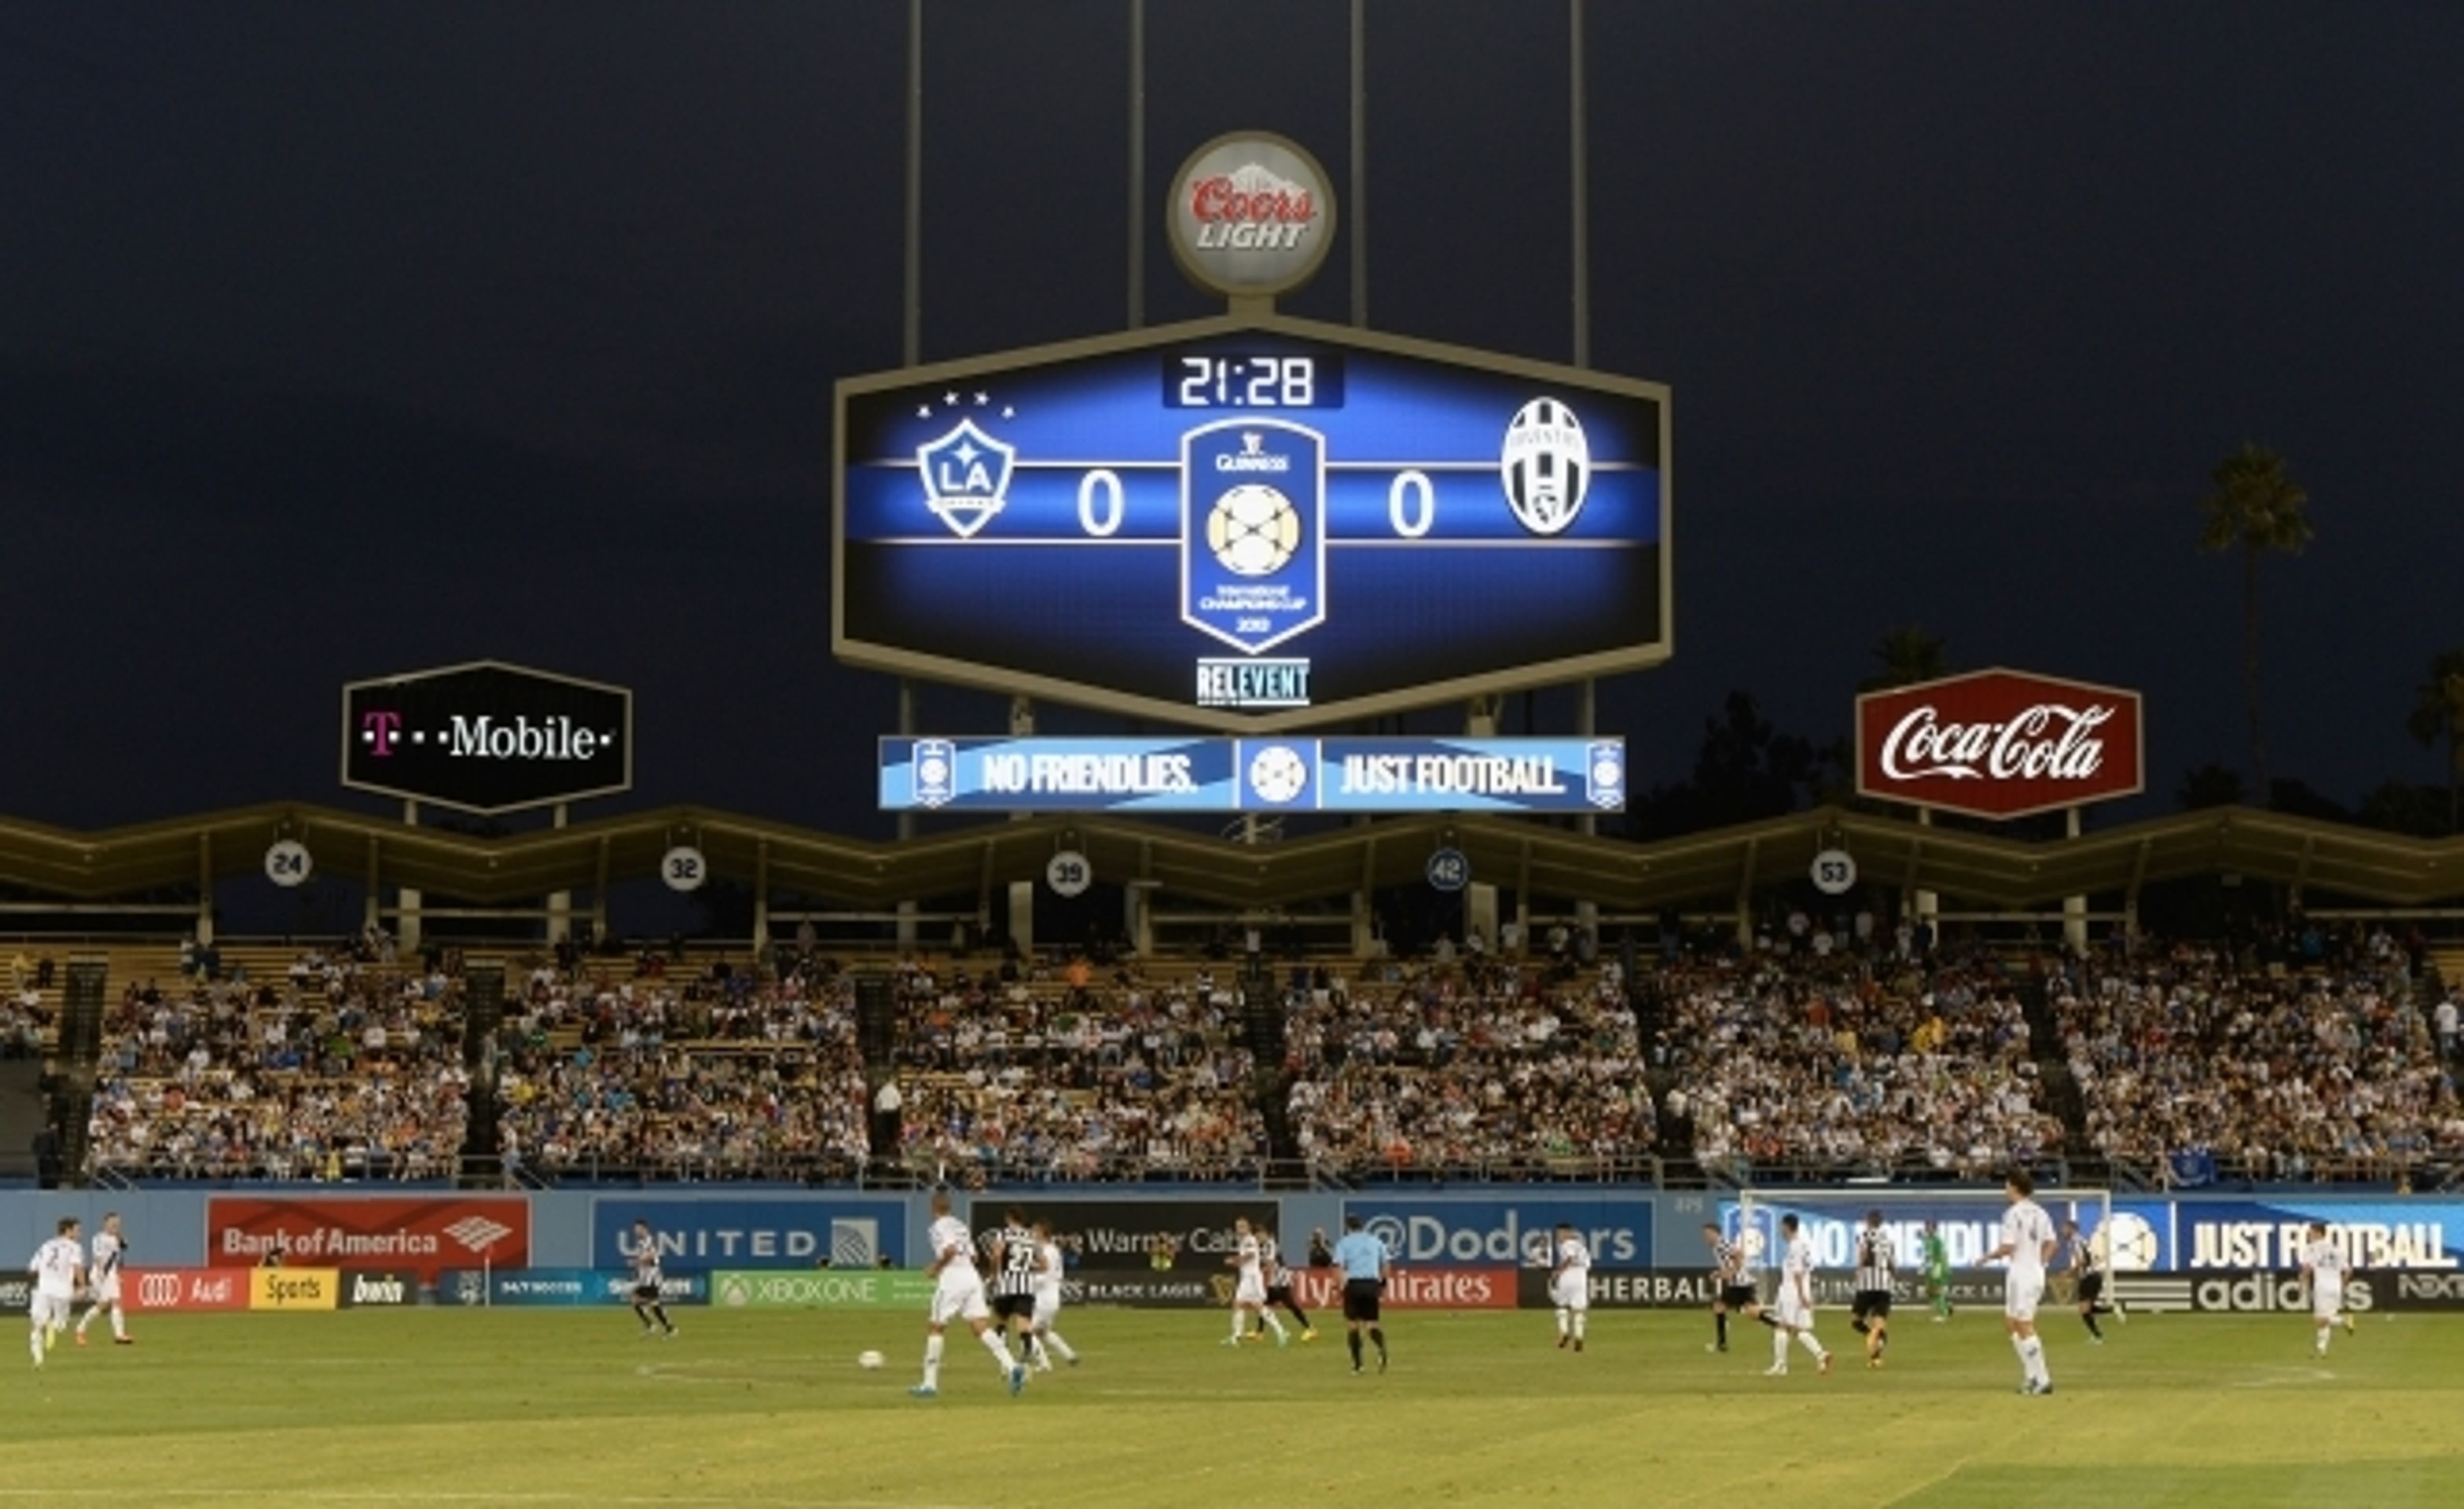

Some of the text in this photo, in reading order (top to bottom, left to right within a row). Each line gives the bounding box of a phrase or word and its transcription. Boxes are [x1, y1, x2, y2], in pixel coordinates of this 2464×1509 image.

[1192, 175, 1316, 223] Coors
[1197, 223, 1308, 249] LIGHT
[1181, 358, 1313, 406] 21:28
[941, 461, 993, 491] LA
[1078, 470, 1124, 536] 0
[1389, 470, 1434, 537] 0
[1197, 665, 1309, 699] RELEVENT
[450, 714, 597, 759] Mobile
[1882, 704, 2117, 780] Coca-Cola
[983, 754, 1027, 793] NO
[1341, 754, 1413, 794] JUST
[273, 853, 302, 875] 24
[670, 857, 699, 879] 32
[1432, 858, 1463, 881] 42
[1820, 861, 1849, 883] 53
[222, 1228, 437, 1254] Bank of America
[616, 1231, 816, 1256] UNITED
[1190, 1228, 1238, 1252] Cab
[2190, 1223, 2274, 1268] JUST
[2279, 1223, 2458, 1268] FOTBALL.
[1008, 1244, 1033, 1272] 27
[191, 1278, 233, 1302] Audi
[266, 1274, 321, 1305] Sports
[354, 1273, 405, 1302] bwin
[1089, 1284, 1144, 1298] BLACK
[1151, 1284, 1205, 1298] LAGER
[2198, 1273, 2373, 1311] adids
